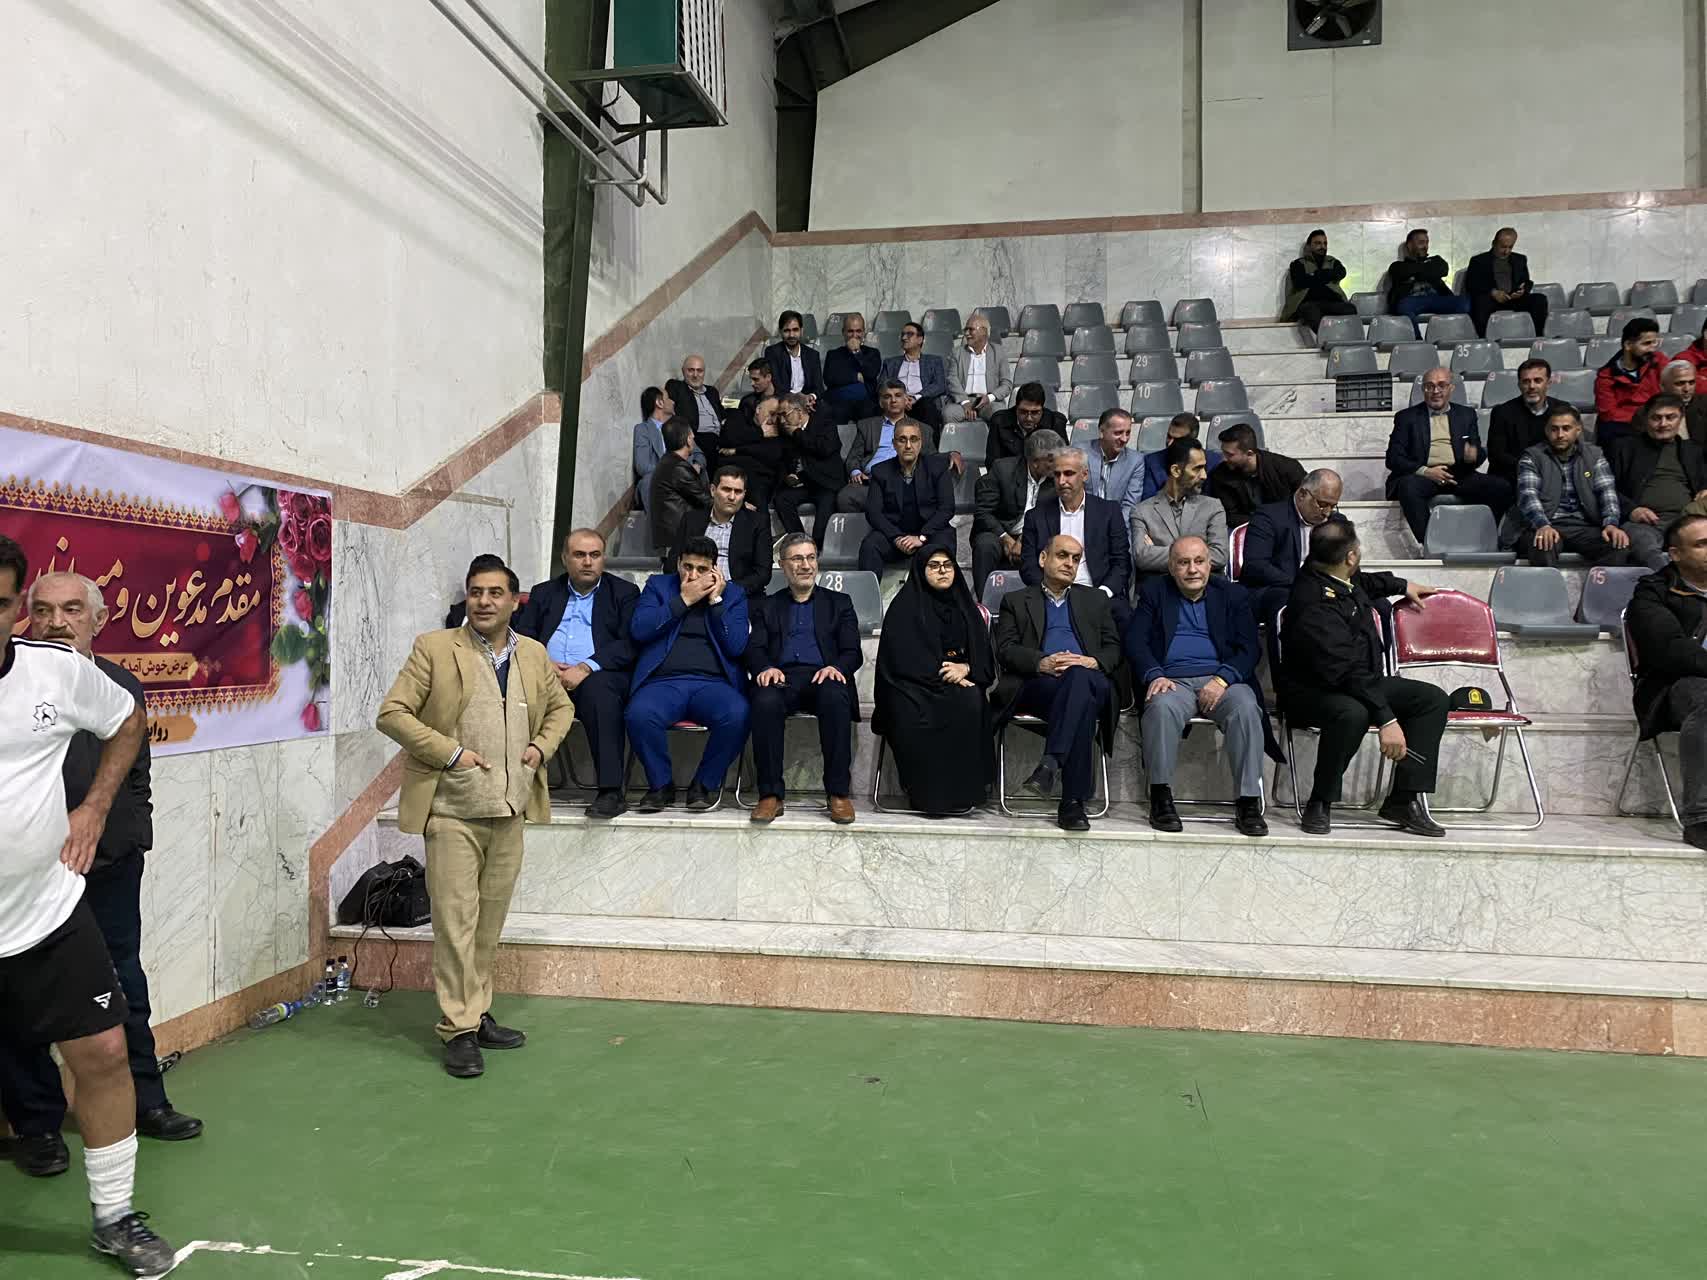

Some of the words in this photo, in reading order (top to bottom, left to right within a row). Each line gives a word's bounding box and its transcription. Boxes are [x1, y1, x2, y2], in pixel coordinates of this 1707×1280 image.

[1457, 344, 1472, 357] 35
[1135, 355, 1148, 368] 29
[1138, 386, 1152, 399] 10
[832, 516, 846, 534] 11
[825, 573, 844, 592] 28
[990, 574, 1005, 588] 19
[1591, 568, 1606, 585] 15
[111, 587, 129, 622] و
[211, 572, 261, 625] مقدم
[131, 570, 208, 648] مدعوین
[141, 659, 168, 676] خوش
[167, 659, 189, 676] عرض
